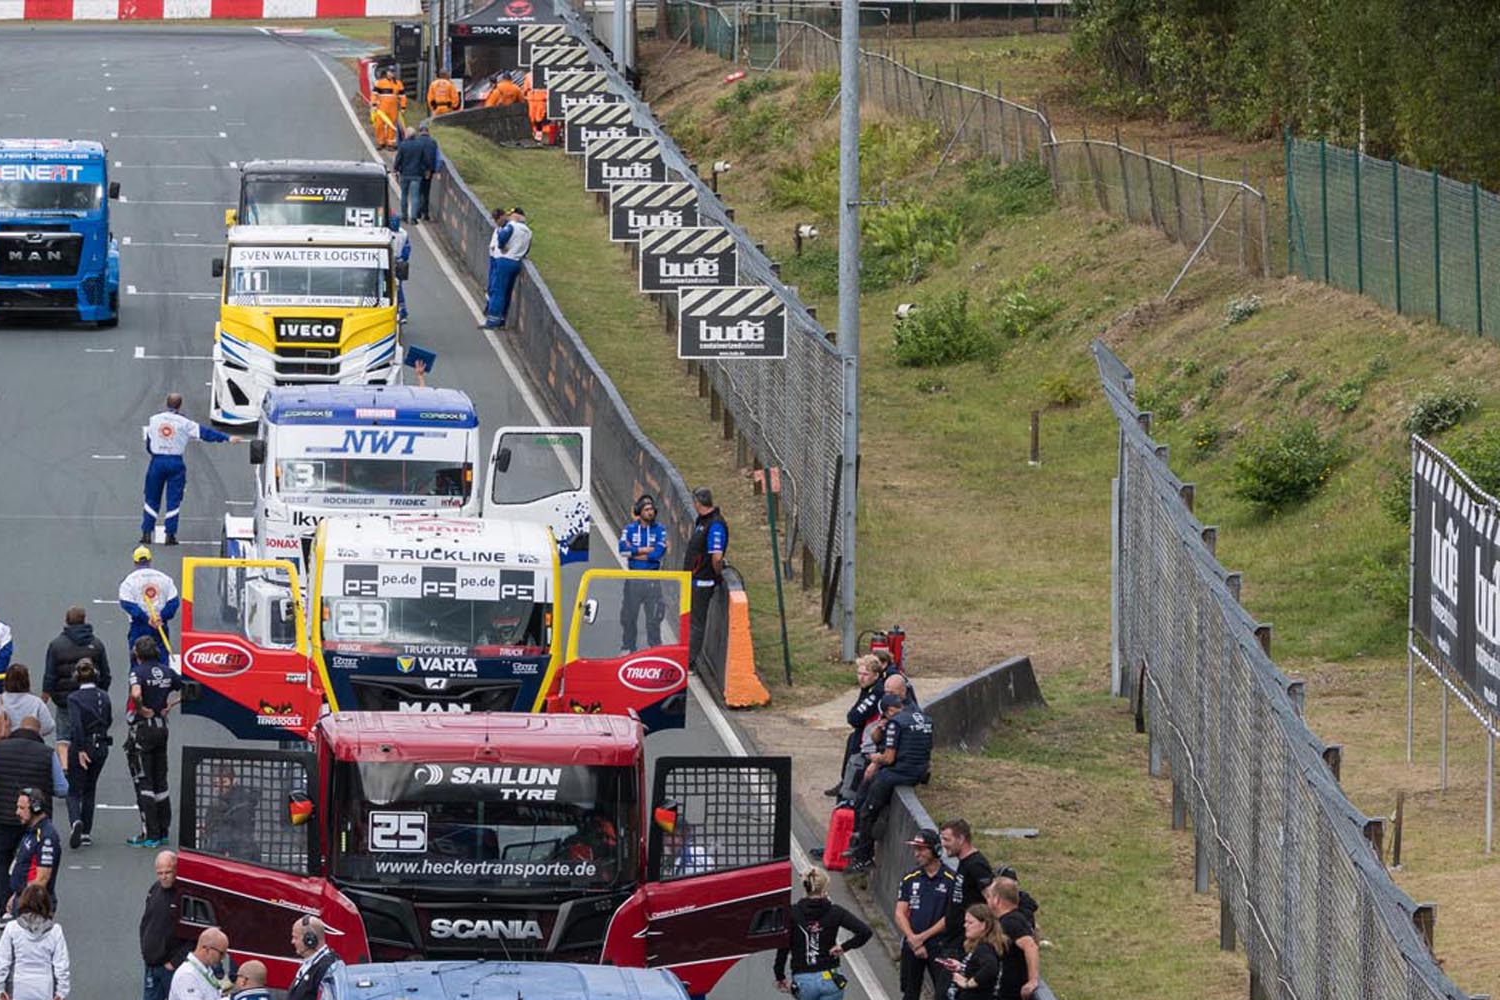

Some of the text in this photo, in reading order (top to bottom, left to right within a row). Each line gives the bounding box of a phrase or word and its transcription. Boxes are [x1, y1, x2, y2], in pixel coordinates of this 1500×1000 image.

[290, 187, 349, 195] AUSTONE
[8, 250, 62, 261] MAN
[240, 251, 379, 262] SVEN WALTER LOGISTIK
[279, 324, 336, 337] IVECO
[341, 430, 421, 455] NWT
[299, 463, 316, 488] 3
[387, 549, 506, 562] TRUCKLINE
[382, 574, 417, 586] pe.de
[460, 576, 496, 589] pe.de
[338, 604, 385, 630] 23
[404, 645, 468, 655] TRUCKFIT.DE
[419, 658, 478, 672] VARTA
[451, 767, 561, 784] SAILUN
[500, 789, 556, 800] TYRE
[372, 814, 425, 848] 25
[376, 860, 596, 878] www.heckertransporte.de
[430, 919, 543, 939] SCANIA
